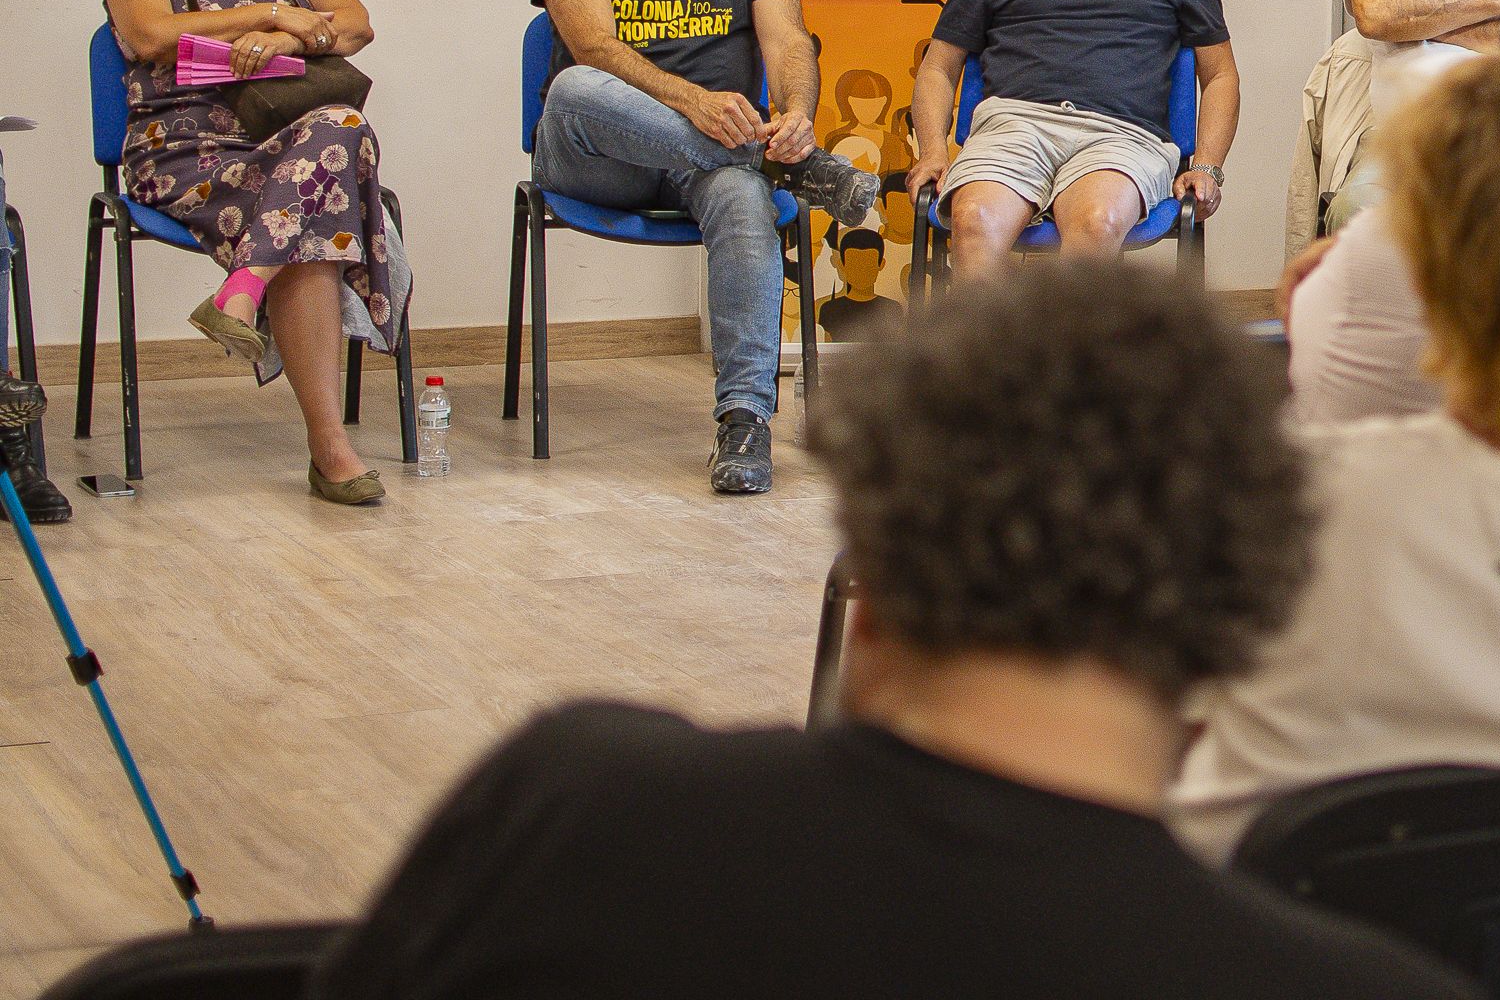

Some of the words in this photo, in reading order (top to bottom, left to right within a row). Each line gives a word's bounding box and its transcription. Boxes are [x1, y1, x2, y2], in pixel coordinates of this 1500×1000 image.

[693, 1, 711, 15] 100
[711, 7, 733, 17] anys
[618, 14, 733, 42] MONTSERRAT
